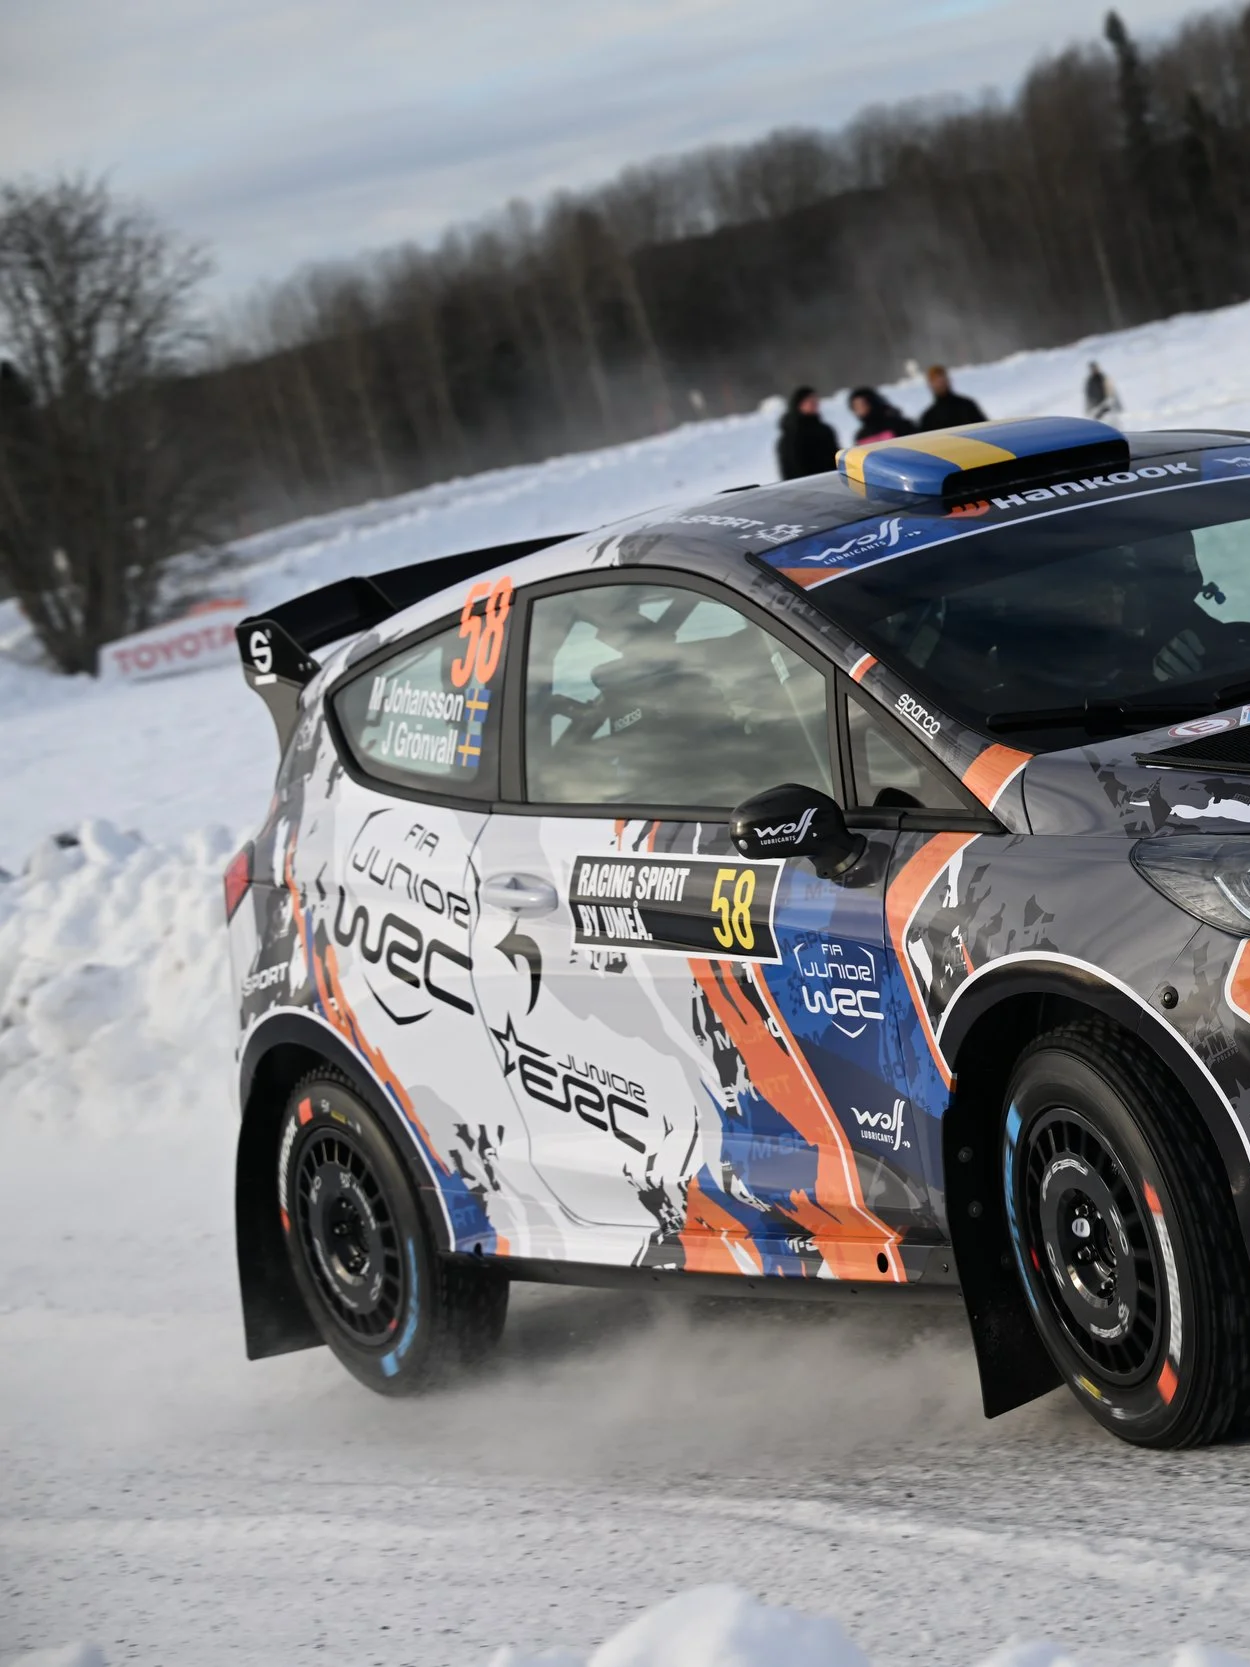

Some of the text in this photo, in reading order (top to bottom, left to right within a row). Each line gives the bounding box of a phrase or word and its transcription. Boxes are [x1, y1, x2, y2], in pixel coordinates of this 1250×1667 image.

[991, 461, 1199, 510] HANKOOK
[824, 541, 886, 565] LUBRICANTS
[114, 622, 237, 674] TOYOTA
[451, 576, 513, 688] 58
[368, 676, 464, 722] M Johansson
[897, 694, 941, 735] sparco
[381, 721, 459, 765] J Grönvall
[404, 823, 440, 858] FIA
[761, 835, 797, 846] LUBRICANTS
[352, 846, 470, 930] JUNIOR
[577, 863, 690, 901] RACING SPIRIT
[578, 904, 597, 937] BY
[711, 868, 756, 950] 58
[334, 885, 475, 1016] WRC
[821, 943, 843, 956] FIA
[804, 962, 872, 982] JUNIOR
[802, 985, 884, 1021] WRC
[557, 1054, 647, 1103] JUNIOR
[861, 1130, 894, 1144] LUBRICANTS
